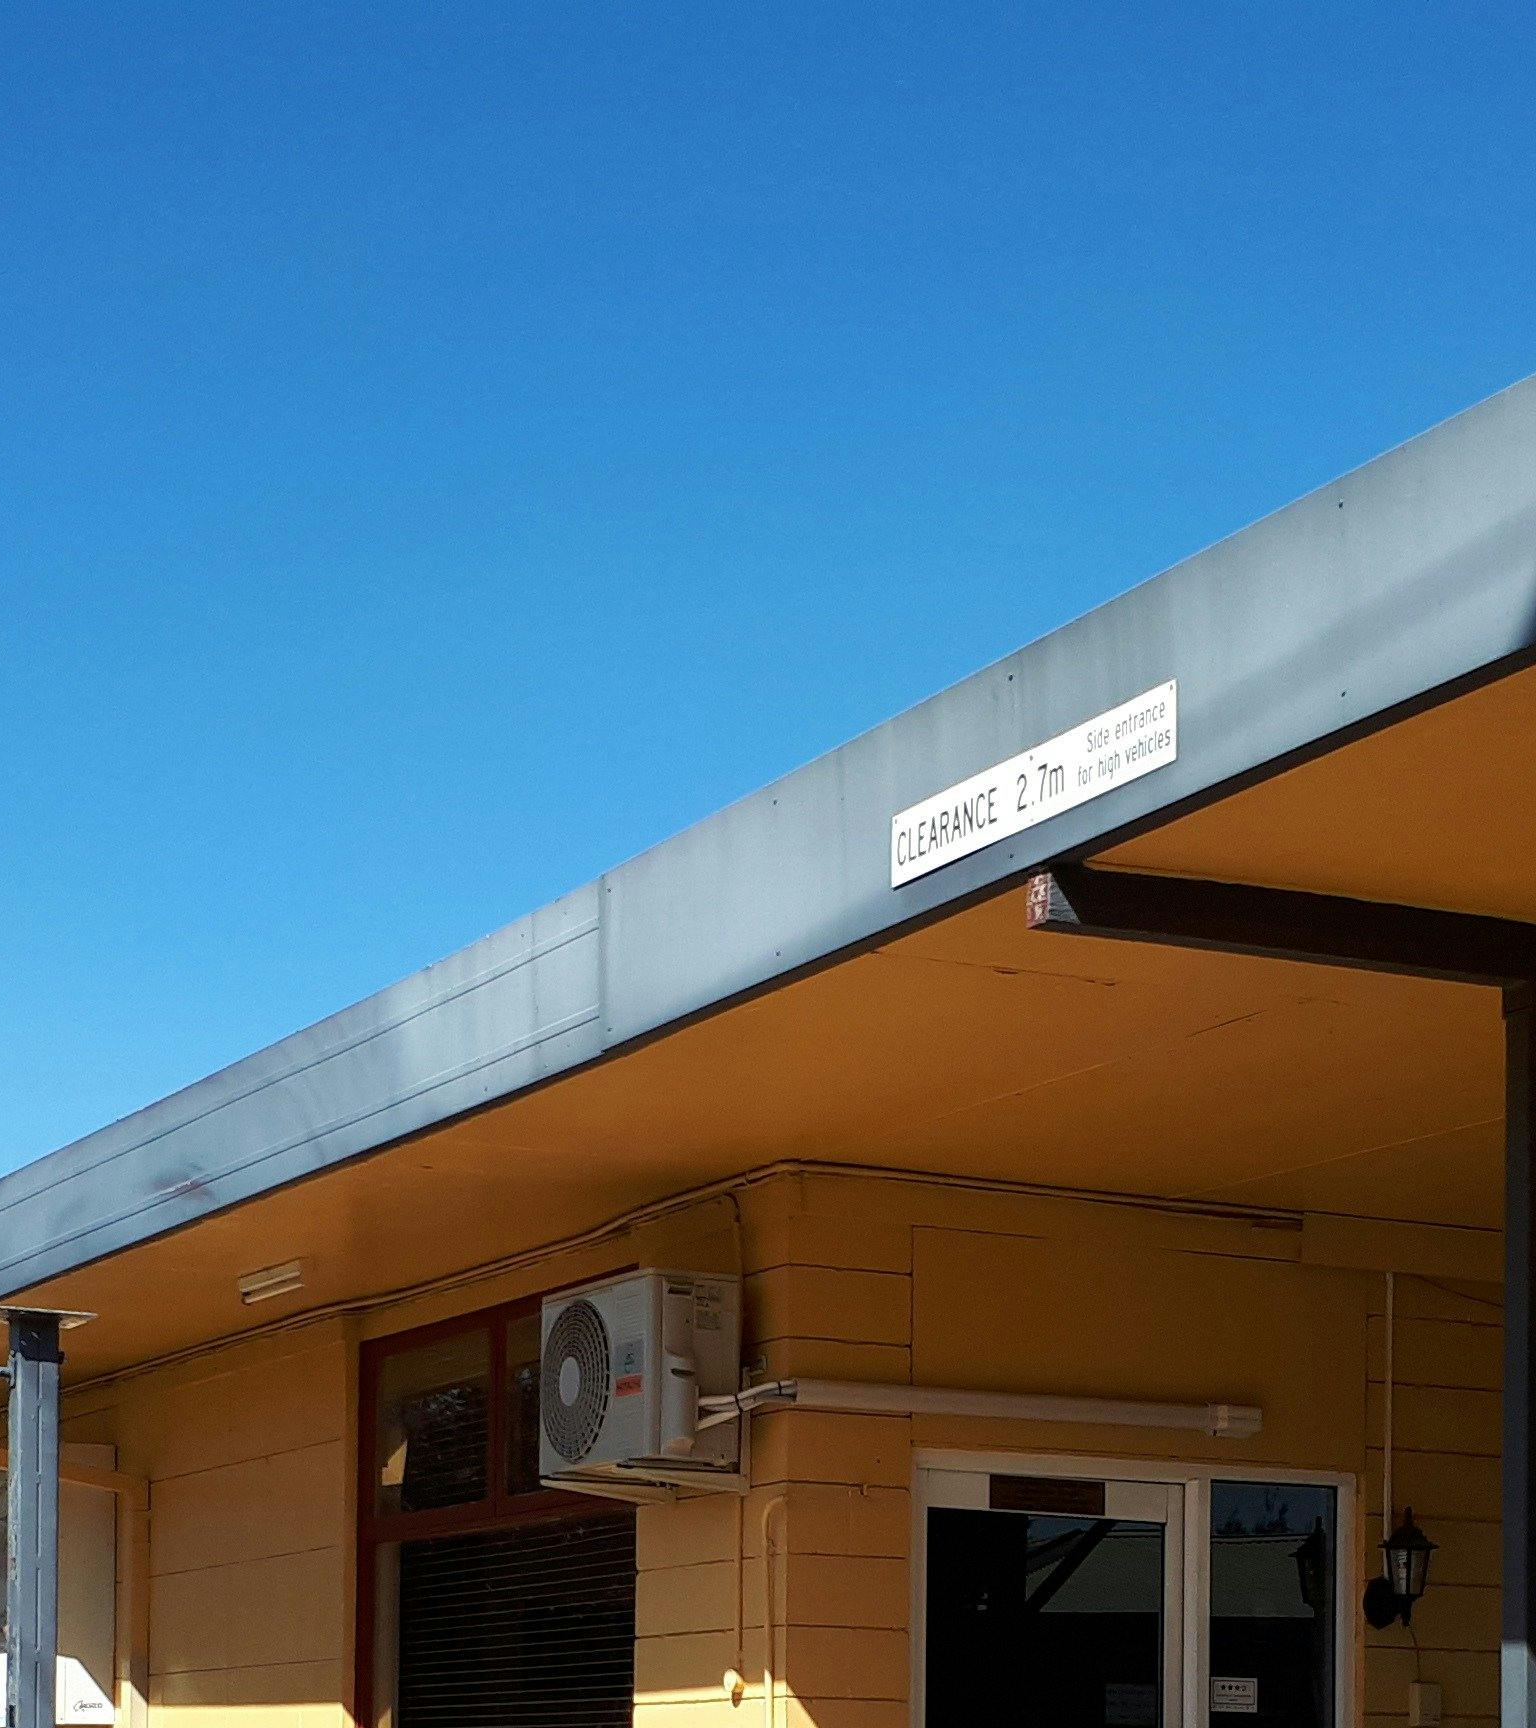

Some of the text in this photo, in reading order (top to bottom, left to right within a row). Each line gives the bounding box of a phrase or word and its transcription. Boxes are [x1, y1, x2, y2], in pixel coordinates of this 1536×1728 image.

[1077, 727, 1172, 787] for high vehicles
[1086, 700, 1166, 754] Side entrance
[896, 762, 1065, 866] CLEARANCE 2.7m
